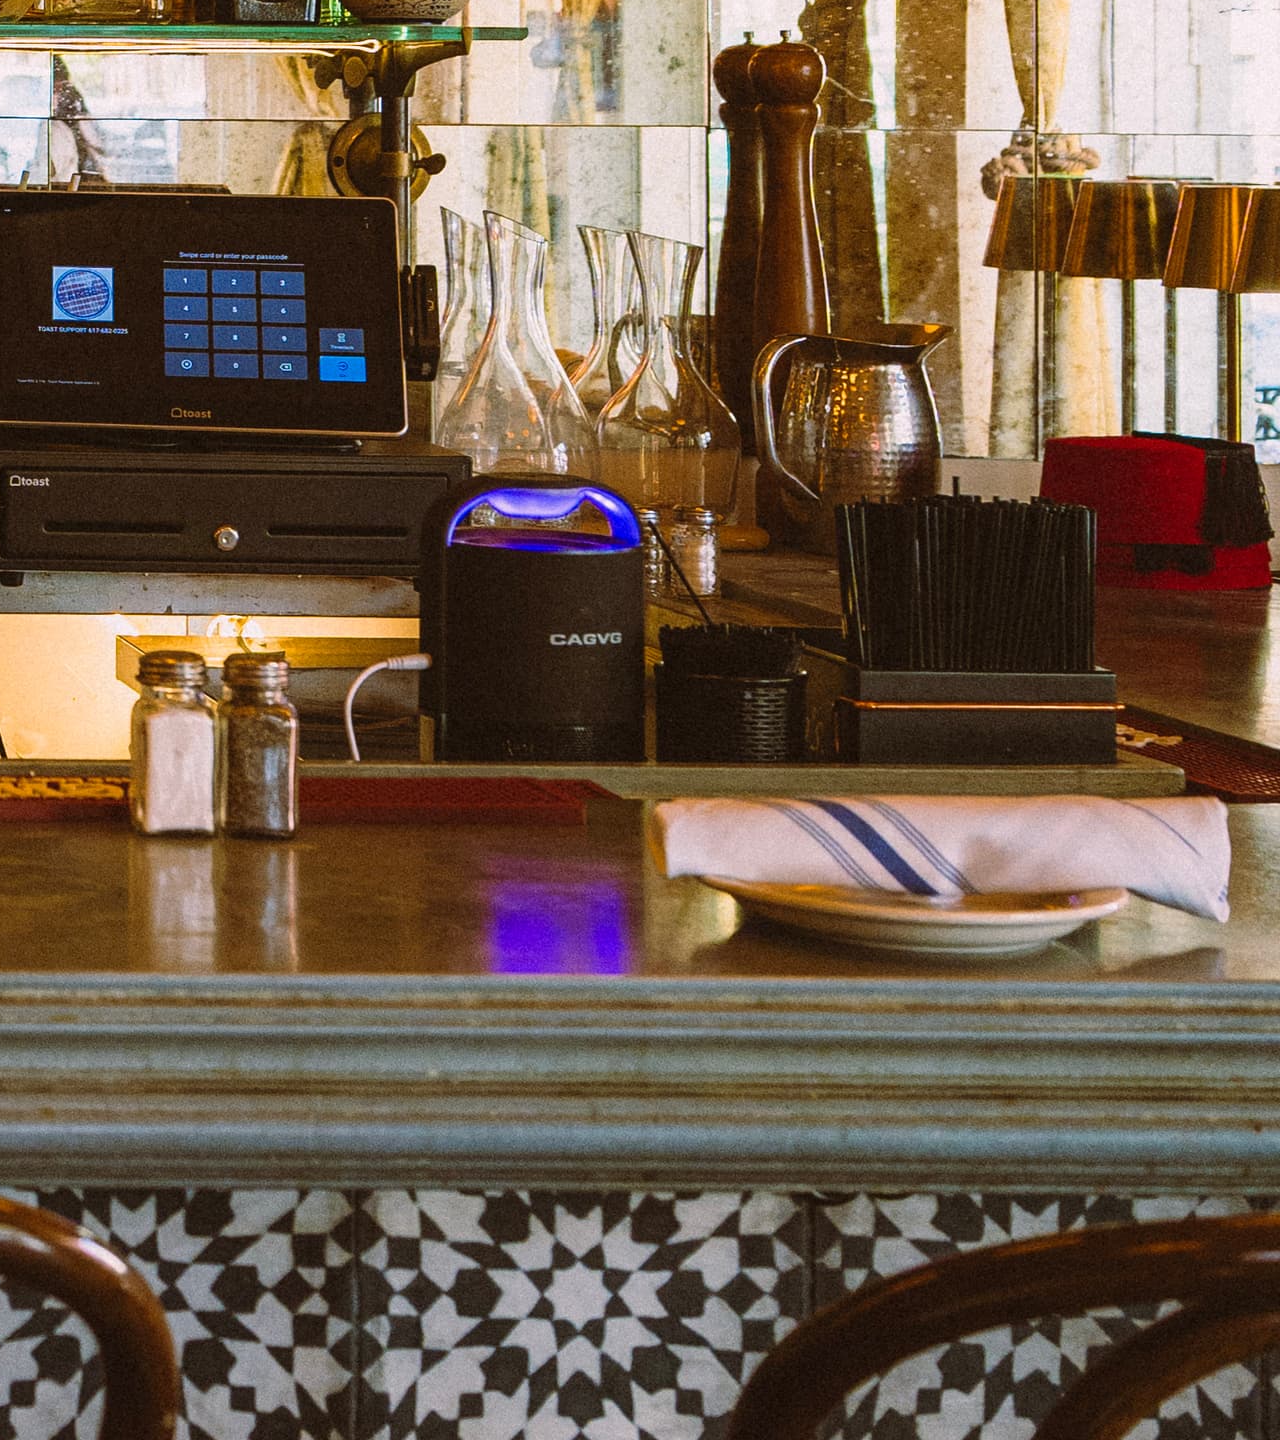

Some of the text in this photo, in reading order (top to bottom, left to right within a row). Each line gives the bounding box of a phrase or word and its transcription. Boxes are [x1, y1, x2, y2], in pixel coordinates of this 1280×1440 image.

[179, 251, 198, 261] Swipe
[199, 252, 214, 260] card
[241, 254, 255, 262] your
[256, 254, 288, 262] passcode
[37, 325, 58, 334] TOAST
[59, 326, 88, 335] SUPPORT
[183, 408, 213, 420] toast
[21, 476, 50, 488] toast
